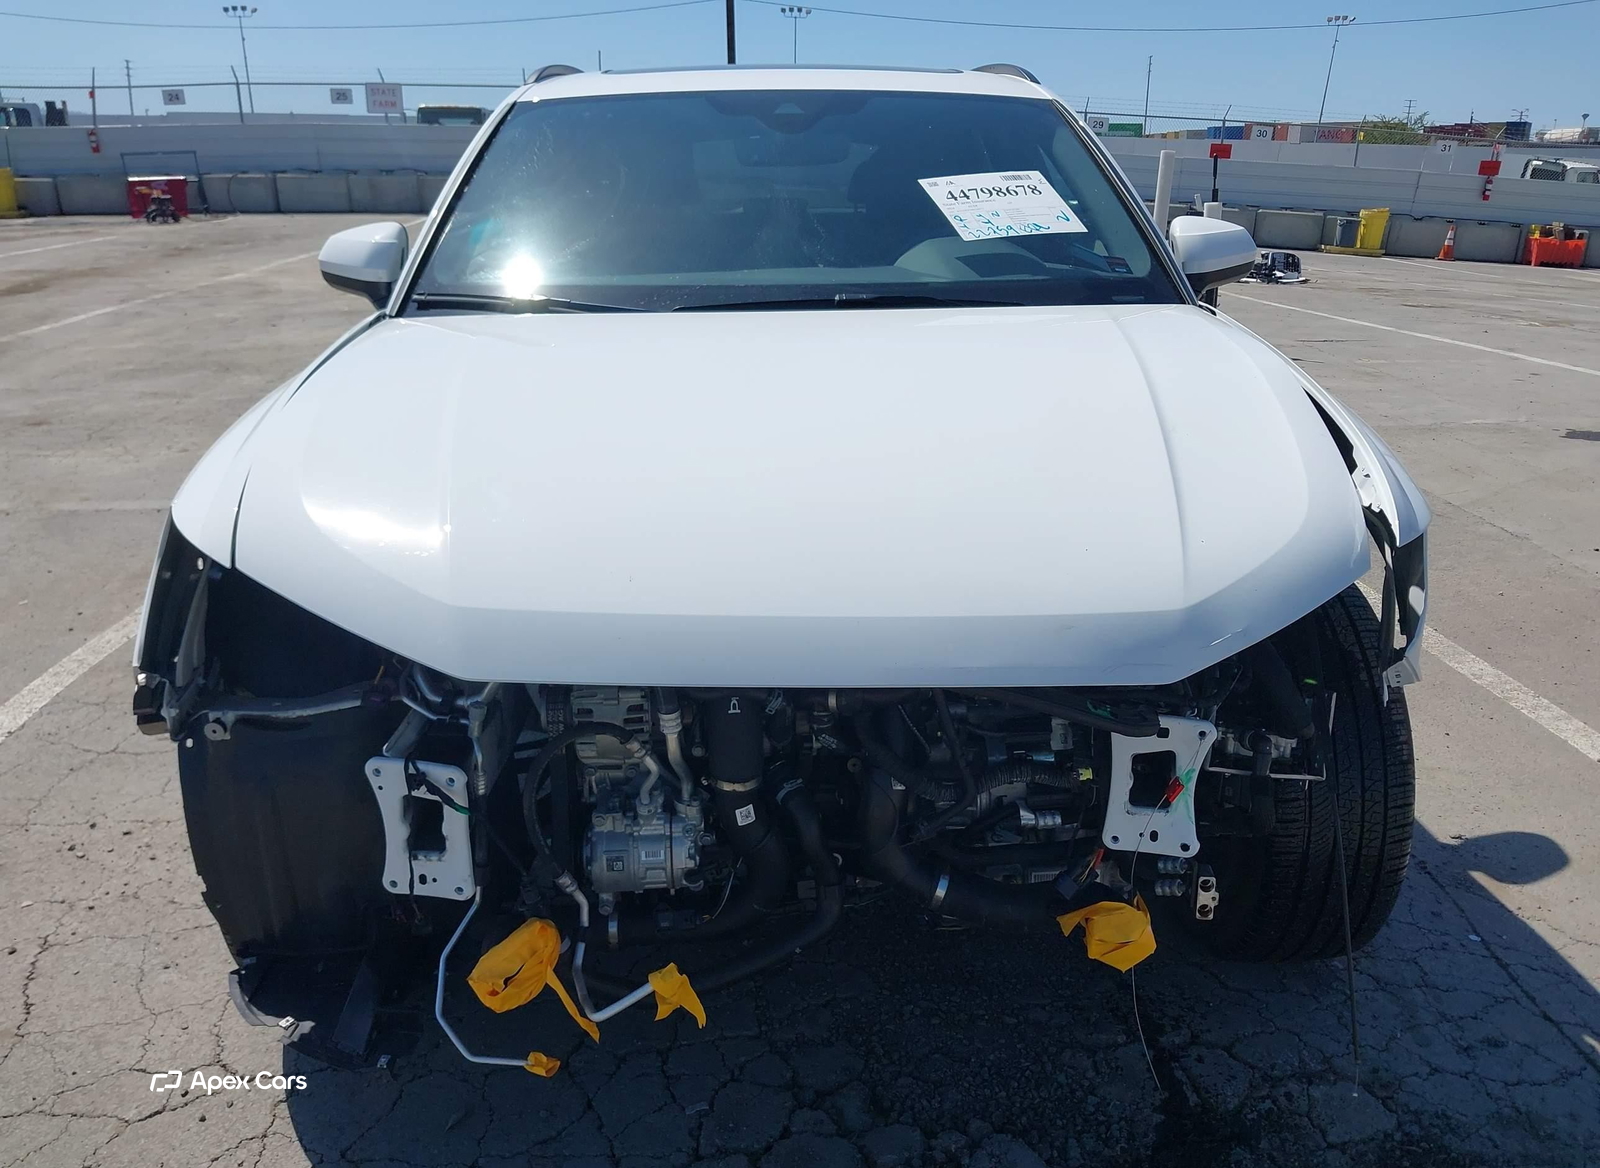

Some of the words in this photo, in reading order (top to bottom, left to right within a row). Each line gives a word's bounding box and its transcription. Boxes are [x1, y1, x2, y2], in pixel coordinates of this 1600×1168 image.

[335, 92, 348, 101] 25
[370, 88, 398, 97] STATE
[167, 93, 180, 102] 24
[372, 99, 397, 108] FARM
[1092, 120, 1104, 129] 29
[1256, 129, 1268, 138] 30
[1440, 144, 1452, 152] 31
[946, 184, 1042, 202] 44798678
